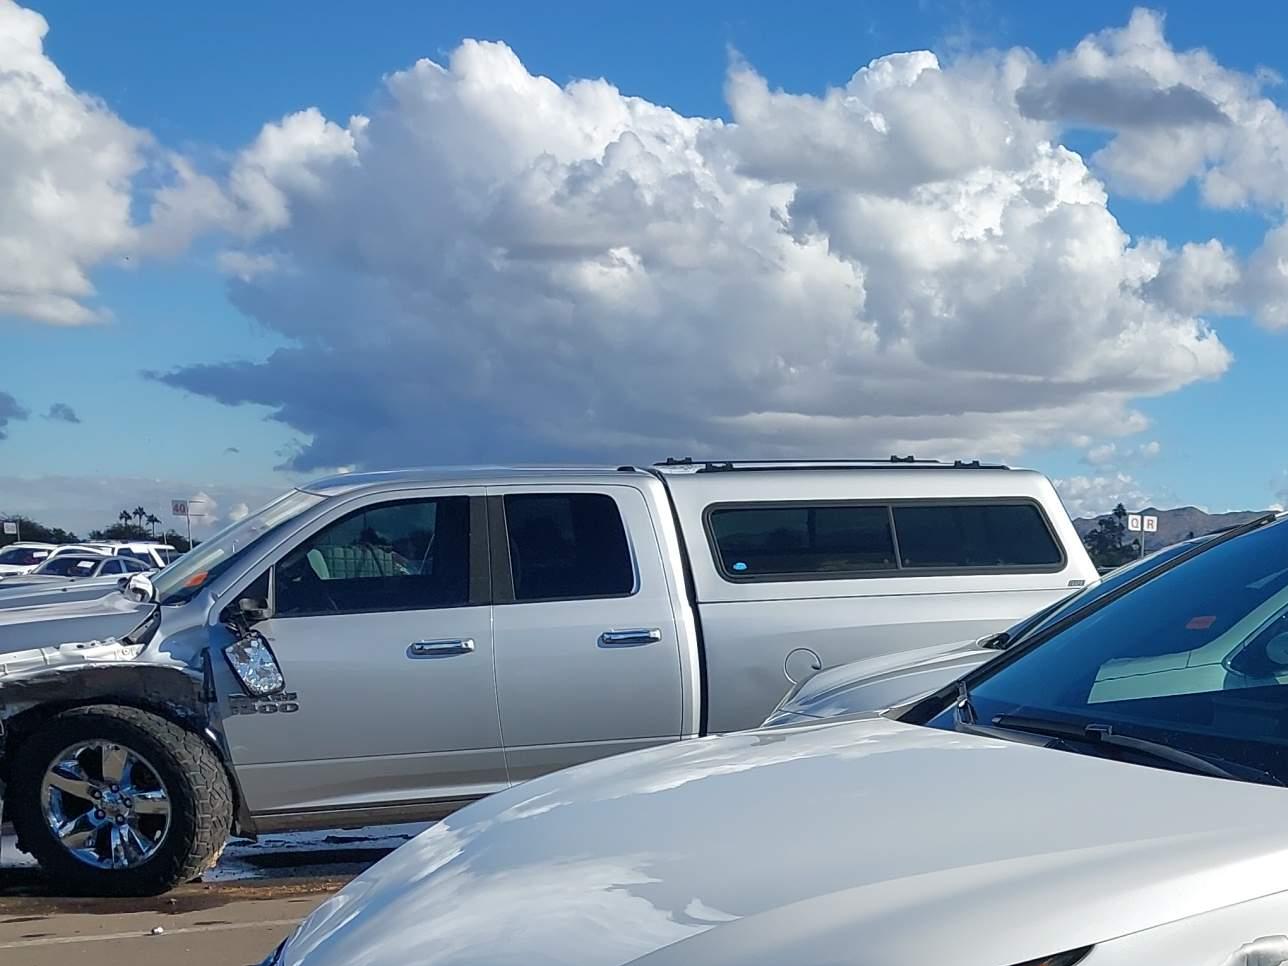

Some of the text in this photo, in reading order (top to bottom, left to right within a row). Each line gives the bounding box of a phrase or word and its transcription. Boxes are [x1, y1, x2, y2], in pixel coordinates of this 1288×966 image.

[173, 503, 186, 513] 40
[1131, 517, 1139, 528] Q
[1147, 519, 1154, 529] R
